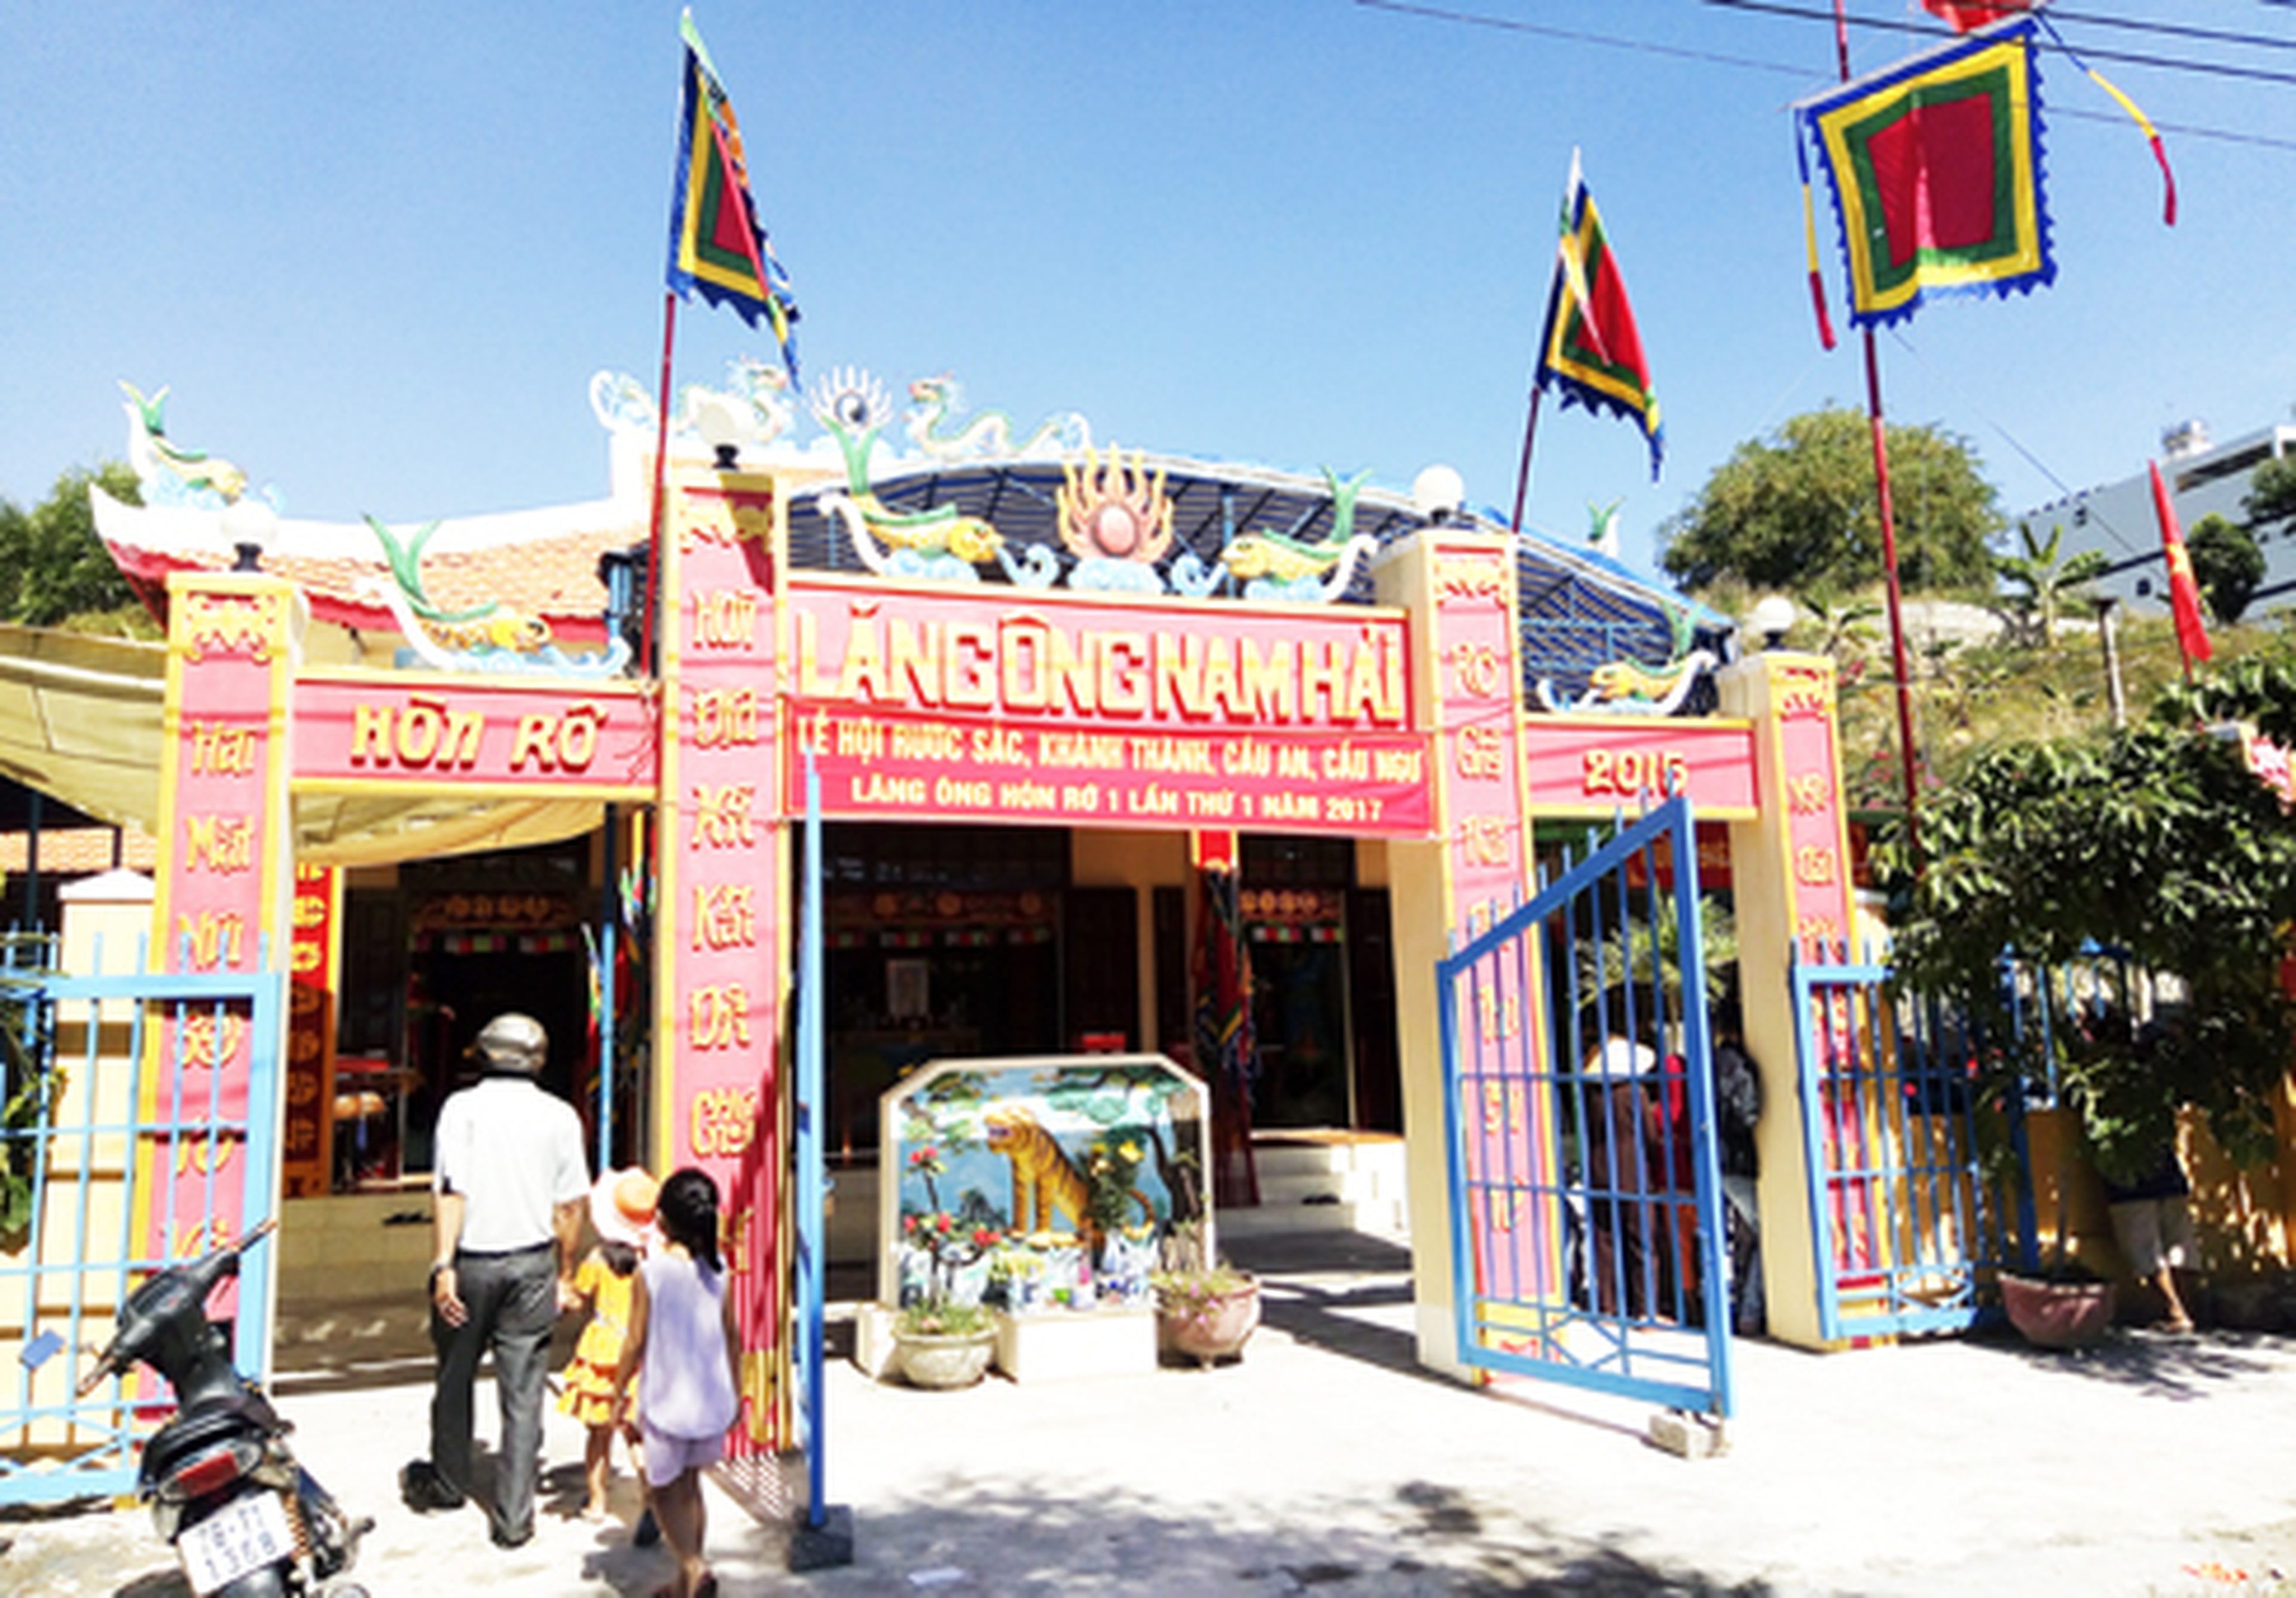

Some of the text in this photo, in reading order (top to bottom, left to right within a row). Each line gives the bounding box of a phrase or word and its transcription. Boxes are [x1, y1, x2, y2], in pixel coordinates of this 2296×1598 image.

[999, 609, 1146, 719] ÔNG
[1152, 631, 1292, 725] NAM
[1296, 621, 1403, 728] HẢI
[935, 774, 992, 807] ÔNG
[1108, 789, 1119, 813] 1
[1241, 795, 1253, 818] 1
[1326, 797, 1384, 822] 2017
